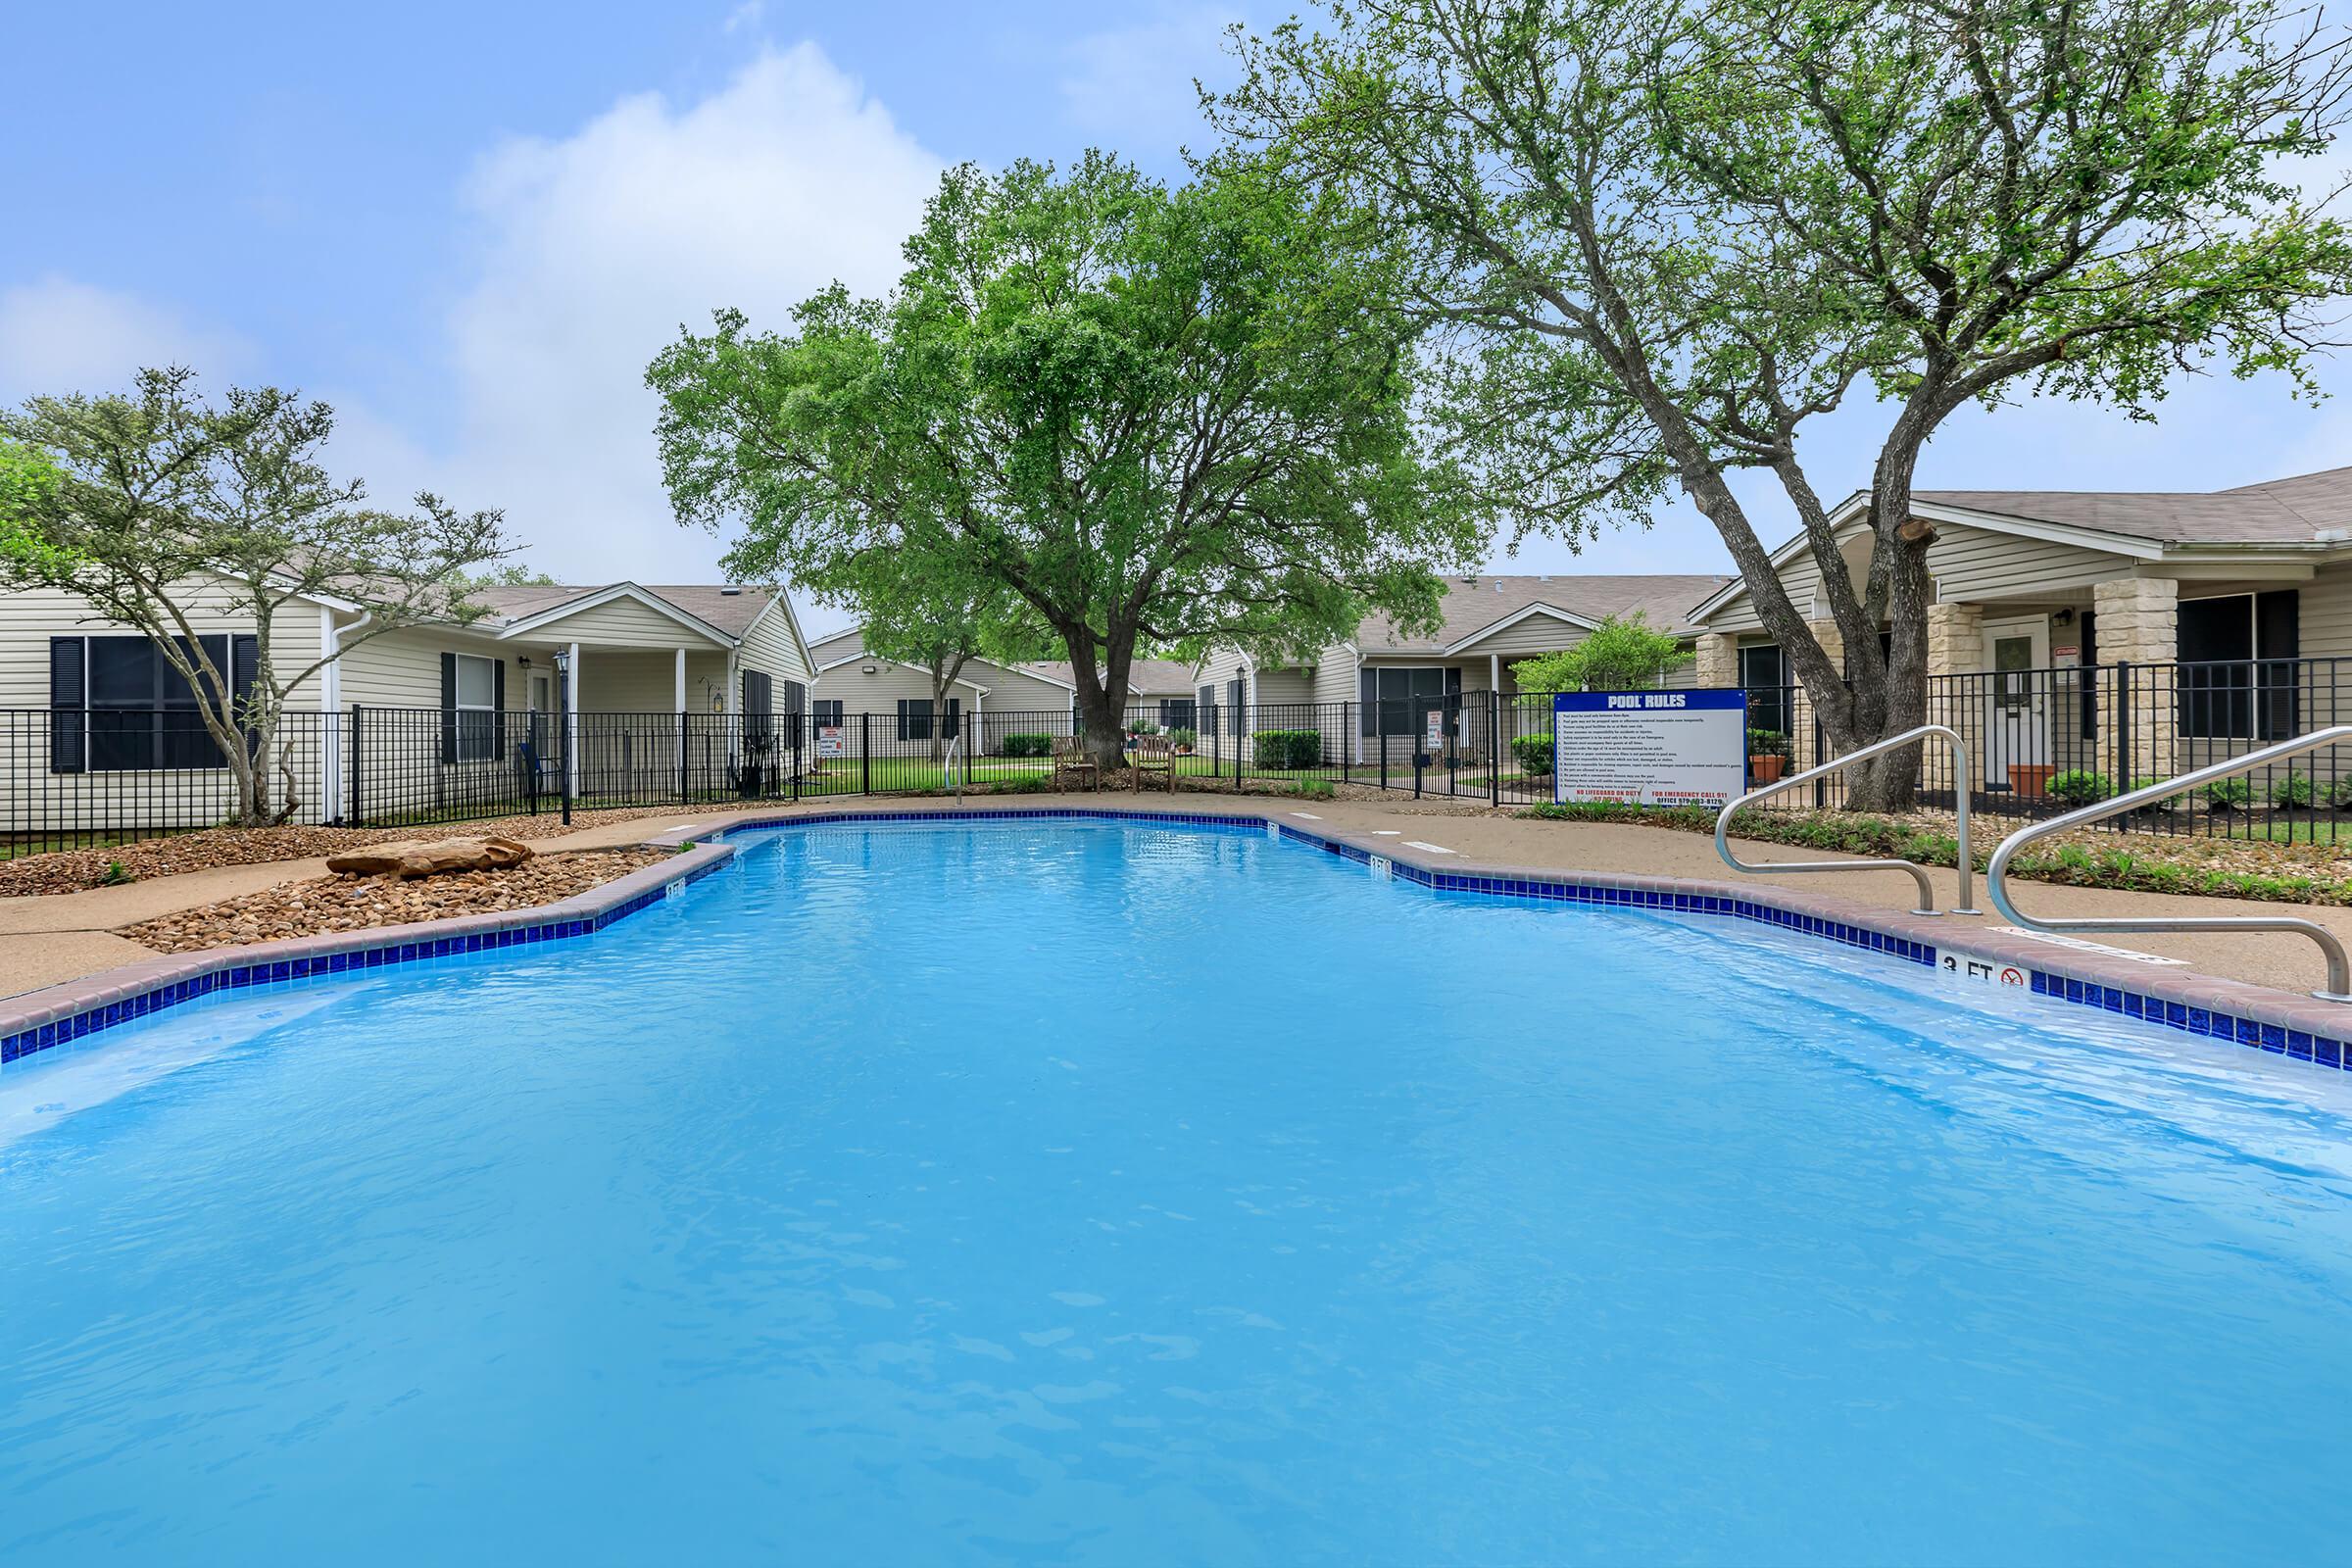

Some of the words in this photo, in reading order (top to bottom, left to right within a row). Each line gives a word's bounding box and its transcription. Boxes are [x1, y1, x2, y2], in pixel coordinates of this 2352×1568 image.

[1608, 695, 1642, 709] POOL
[1644, 694, 1686, 708] RULES
[1944, 956, 1957, 972] 3
[1968, 961, 1993, 980] FT
